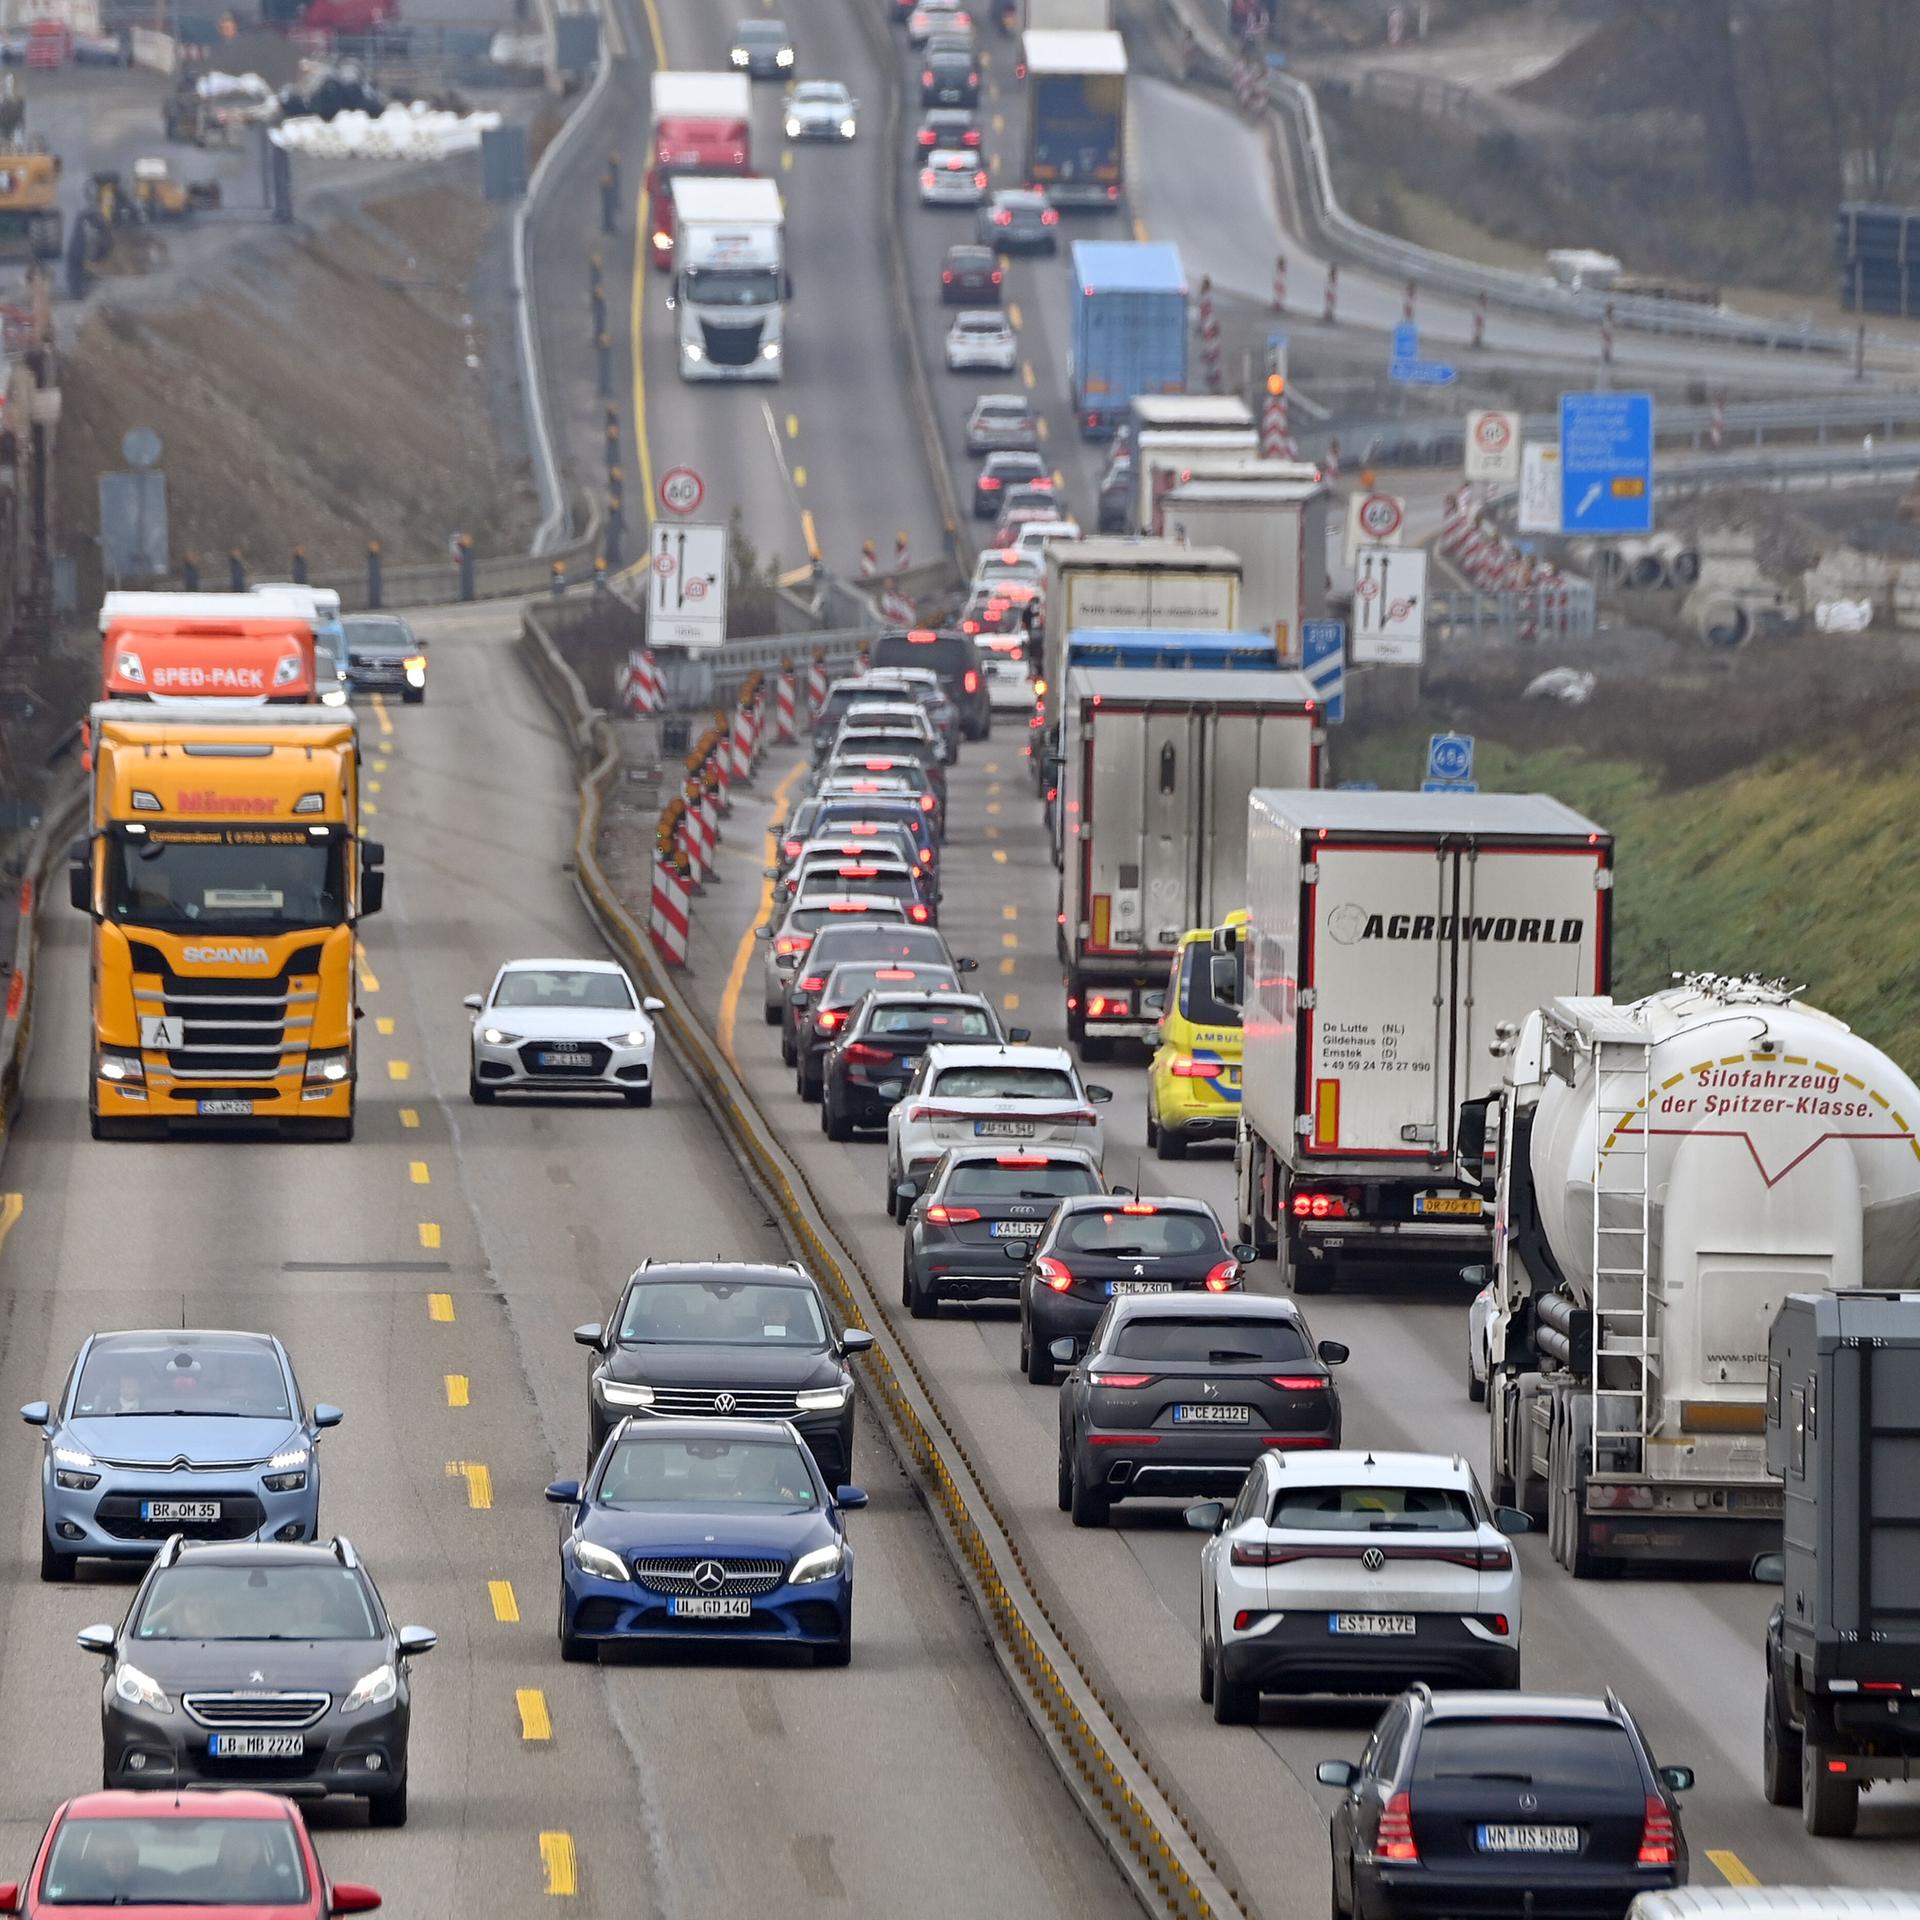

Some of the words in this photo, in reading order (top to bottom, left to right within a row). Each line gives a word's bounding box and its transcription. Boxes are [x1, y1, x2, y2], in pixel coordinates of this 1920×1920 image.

[152, 668, 265, 687] SPED-PACK
[1362, 914, 1584, 943] AGROWORLD
[183, 947, 269, 964] SCANIA
[153, 1020, 171, 1045] A
[1323, 1023, 1337, 1032] De
[1340, 1023, 1368, 1033] Lutte
[1382, 1024, 1405, 1035] (NL)
[1323, 1036, 1376, 1046] Gildehaus
[1381, 1036, 1398, 1048] (D)
[1323, 1048, 1362, 1058] Emstek
[1381, 1049, 1398, 1060] (D)
[1332, 1061, 1344, 1070] 49
[1363, 1061, 1376, 1071] 24
[1396, 1062, 1408, 1071] 27
[1412, 1062, 1431, 1072] 990
[1698, 1069, 1840, 1094] Silofahrzeug
[1661, 1096, 1697, 1113] der
[1704, 1095, 1874, 1118] Spitzer-Klasse.
[997, 1223, 1011, 1233] KA
[1018, 1223, 1032, 1233] LG
[1112, 1282, 1118, 1293] S
[1182, 1406, 1188, 1418] D
[1195, 1406, 1209, 1419] CE
[153, 1504, 170, 1516] BR
[178, 1504, 196, 1516] OM
[198, 1504, 215, 1516] 35
[677, 1600, 694, 1613] UL
[703, 1601, 721, 1614] GD
[724, 1601, 749, 1614] 140
[1338, 1615, 1356, 1630] ES
[1367, 1616, 1375, 1630] T
[219, 1737, 236, 1753] LB
[247, 1737, 264, 1753] MB
[268, 1737, 302, 1753] 2226
[1488, 1827, 1506, 1845] WN
